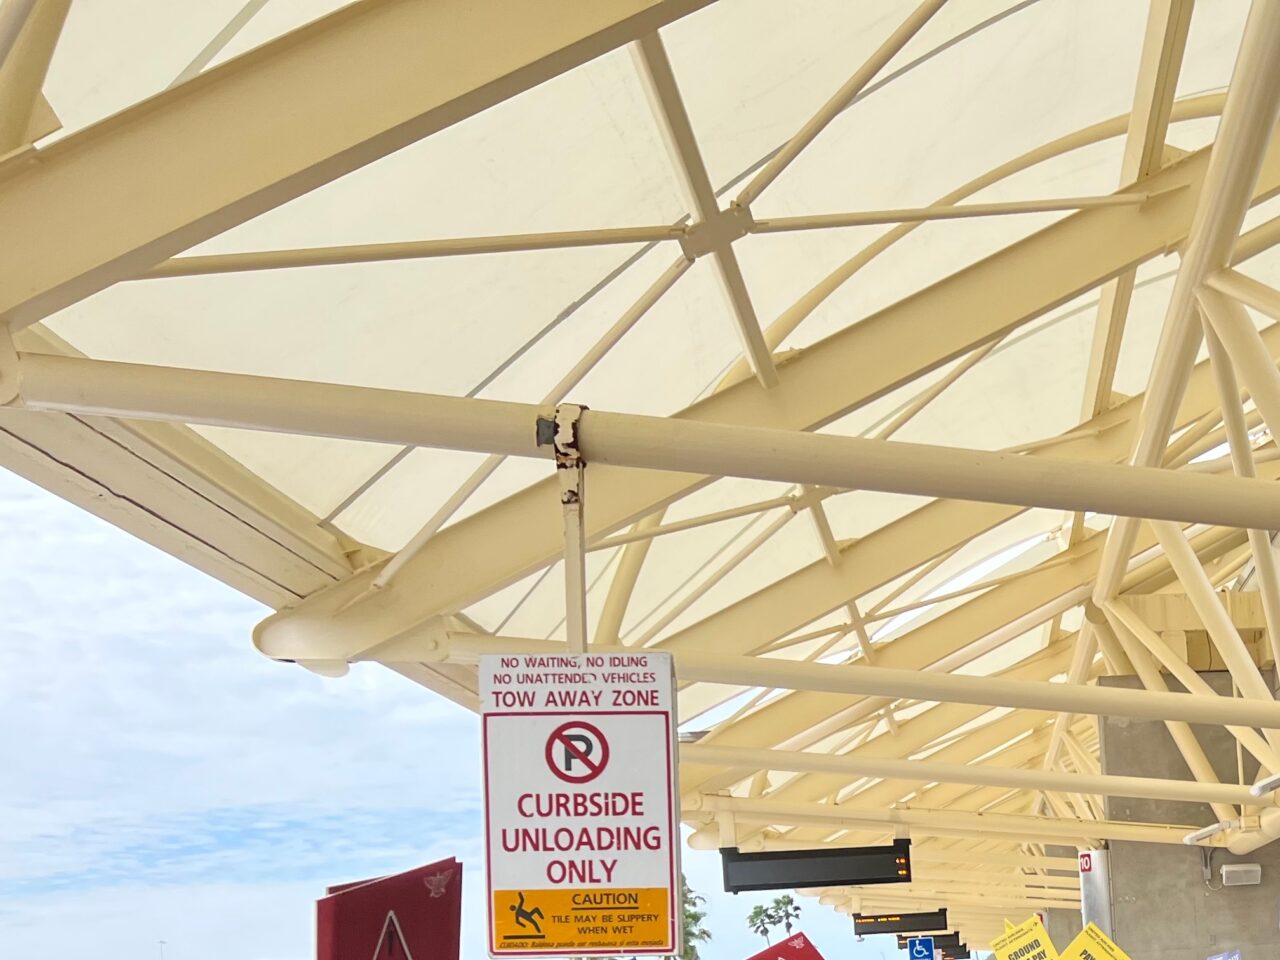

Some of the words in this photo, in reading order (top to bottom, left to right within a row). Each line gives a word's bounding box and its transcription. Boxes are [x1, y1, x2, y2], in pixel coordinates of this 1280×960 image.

[501, 657, 519, 668] NO
[524, 657, 581, 669] WAITING,
[586, 657, 604, 667] NO
[609, 656, 647, 667] IDLING
[494, 674, 512, 684] NO
[602, 672, 656, 683] VEHICLES
[492, 691, 535, 708] TOW
[545, 691, 602, 707] AWAY
[612, 690, 659, 706] ZONE
[518, 792, 645, 817] CURBSIDE
[502, 826, 661, 852] UNLOADING
[1080, 857, 1090, 870] 10
[547, 860, 618, 884] ONLY
[572, 893, 639, 905] CAUTION
[552, 915, 571, 923] TILE
[575, 914, 598, 923] MAY
[602, 914, 614, 923] BE
[617, 914, 659, 923] SLIPPERY
[577, 926, 608, 935] WHEN
[612, 925, 634, 934] WET
